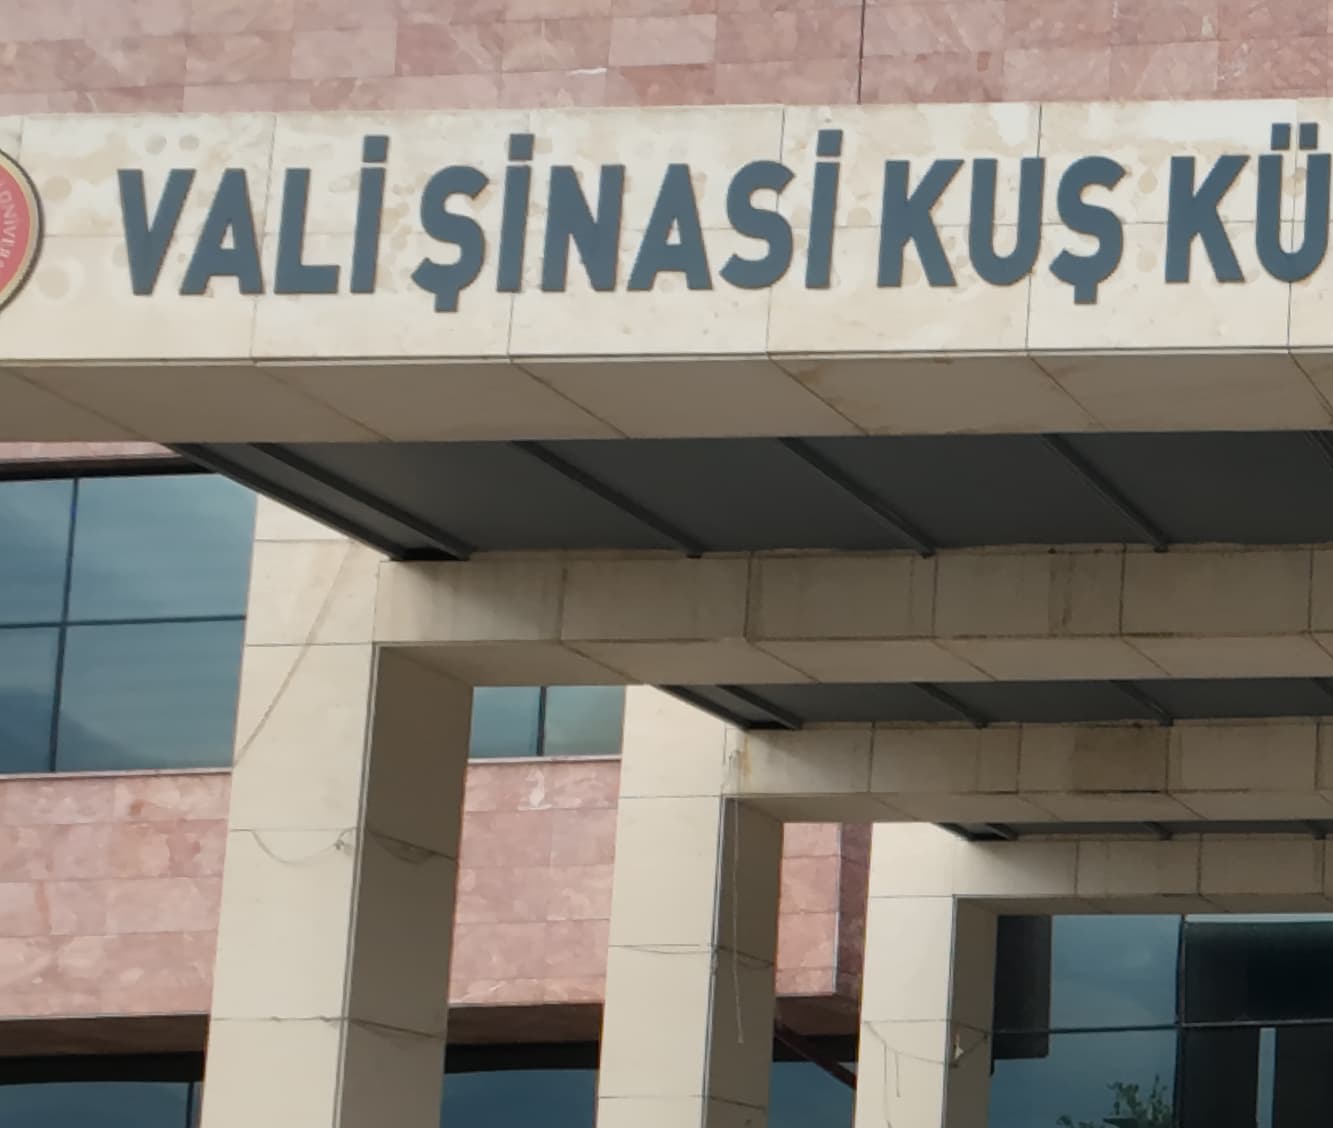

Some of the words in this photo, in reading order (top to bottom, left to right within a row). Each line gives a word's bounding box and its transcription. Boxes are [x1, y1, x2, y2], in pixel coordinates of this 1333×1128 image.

[118, 135, 389, 296] VALİ
[411, 130, 843, 313] ŞİNASİ
[876, 155, 1126, 305] KUŞ
